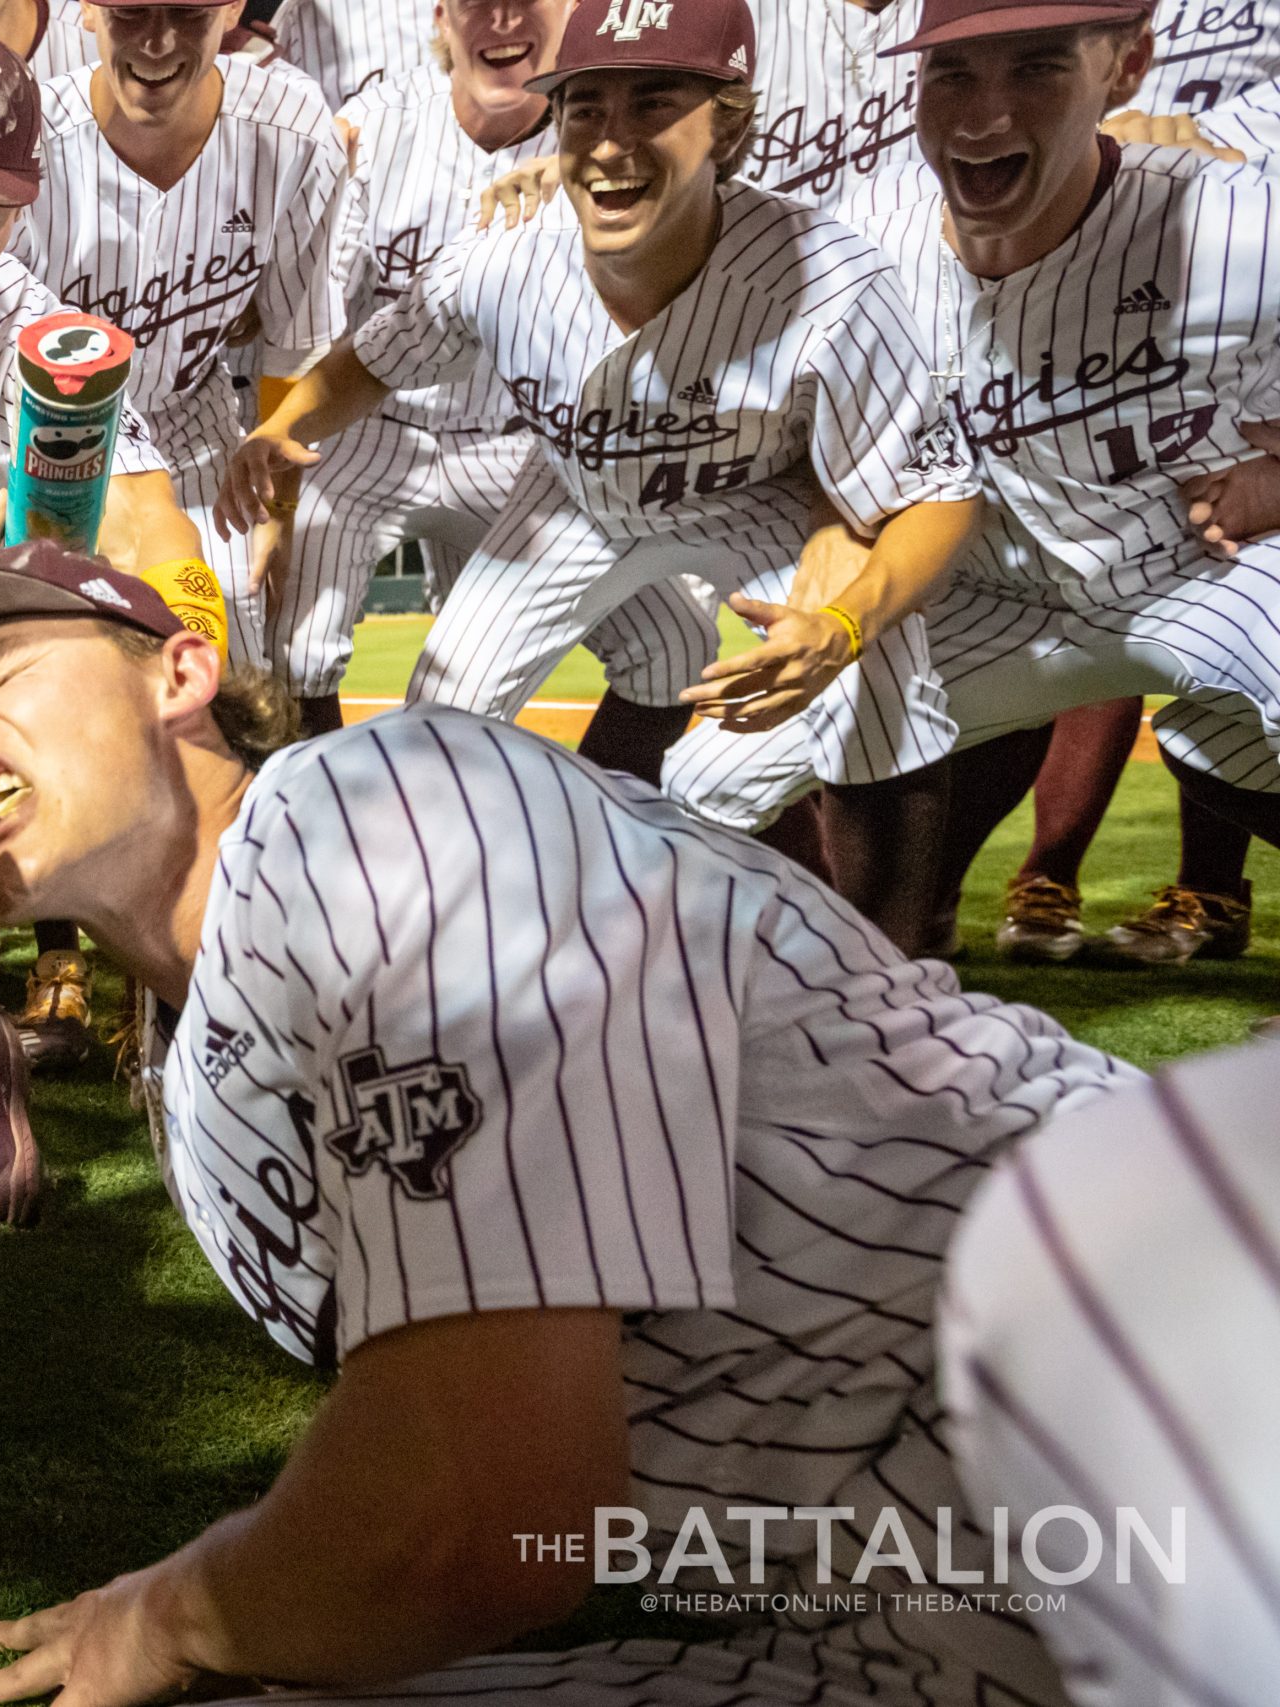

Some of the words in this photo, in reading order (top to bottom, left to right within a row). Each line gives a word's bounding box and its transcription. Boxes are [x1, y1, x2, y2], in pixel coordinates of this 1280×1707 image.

[748, 70, 916, 196] Aggi
[222, 223, 255, 232] adidas
[1113, 299, 1171, 315] adidas
[947, 337, 1190, 468] gies
[28, 451, 103, 481] PRINGLES
[1095, 403, 1221, 485] 19
[638, 455, 756, 511] 46
[206, 1030, 256, 1090] adidas
